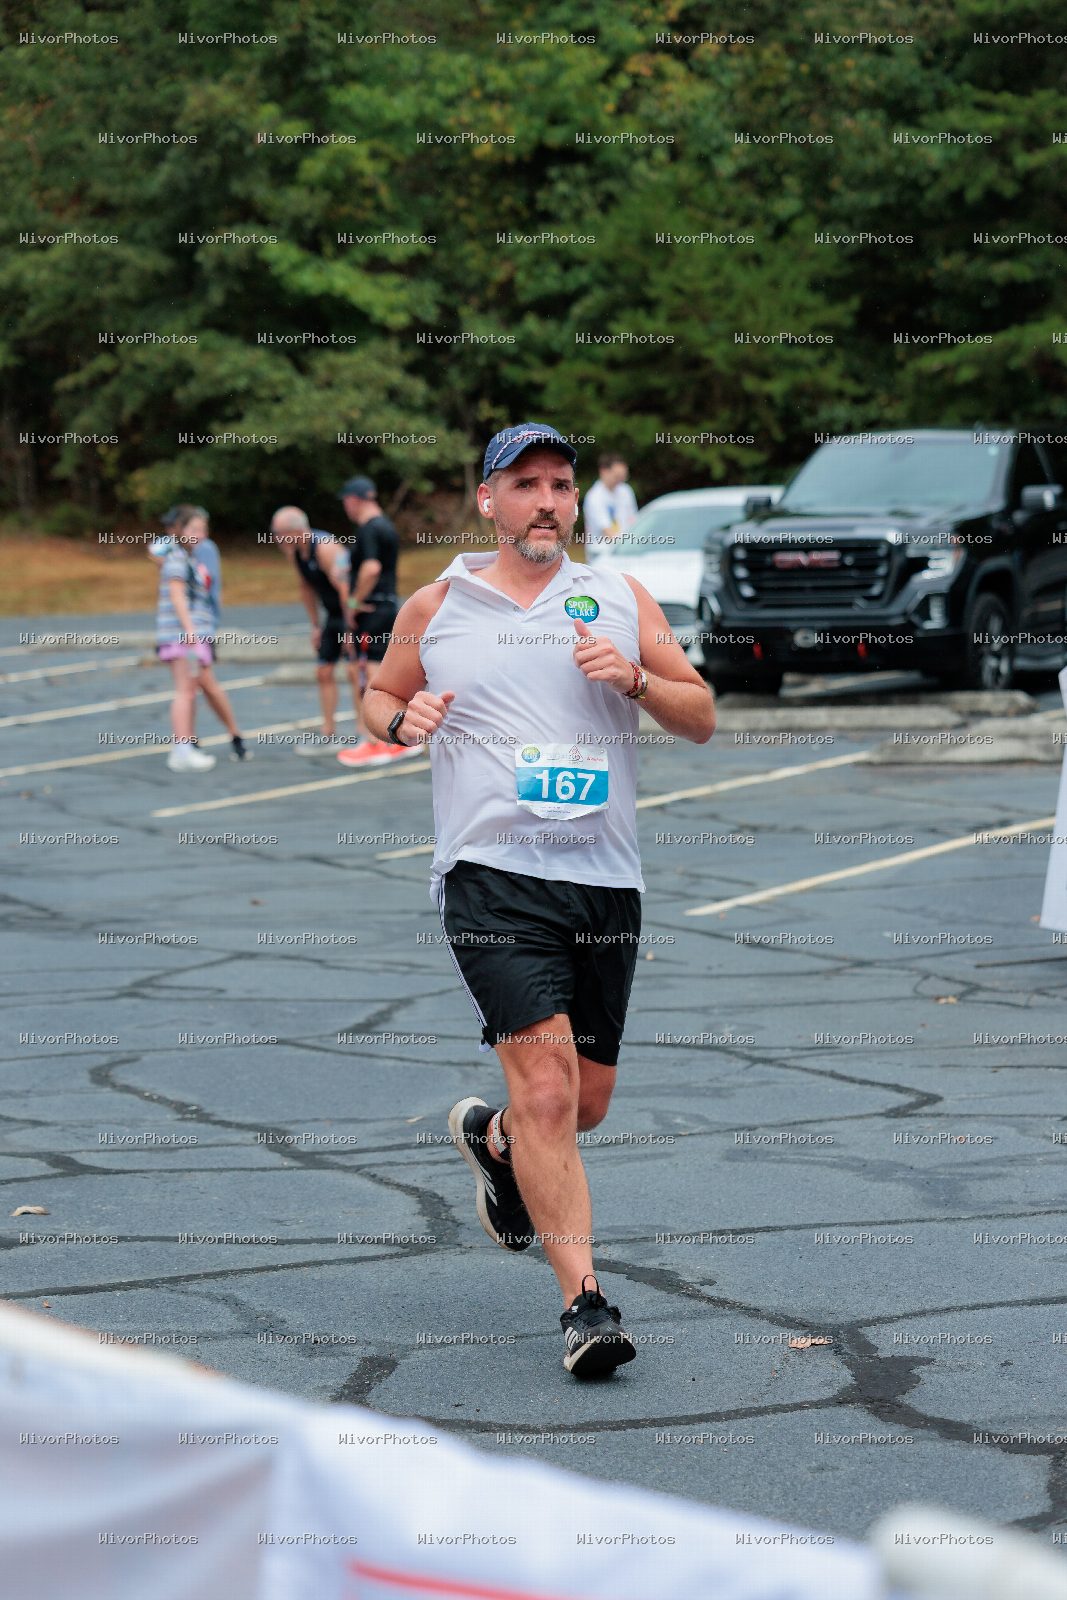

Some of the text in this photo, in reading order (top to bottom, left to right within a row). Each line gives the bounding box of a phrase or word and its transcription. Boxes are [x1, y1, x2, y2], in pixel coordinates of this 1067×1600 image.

[772, 551, 840, 568] GMC
[568, 600, 589, 609] SPOT
[575, 608, 595, 617] LAKE
[536, 769, 596, 801] 167
